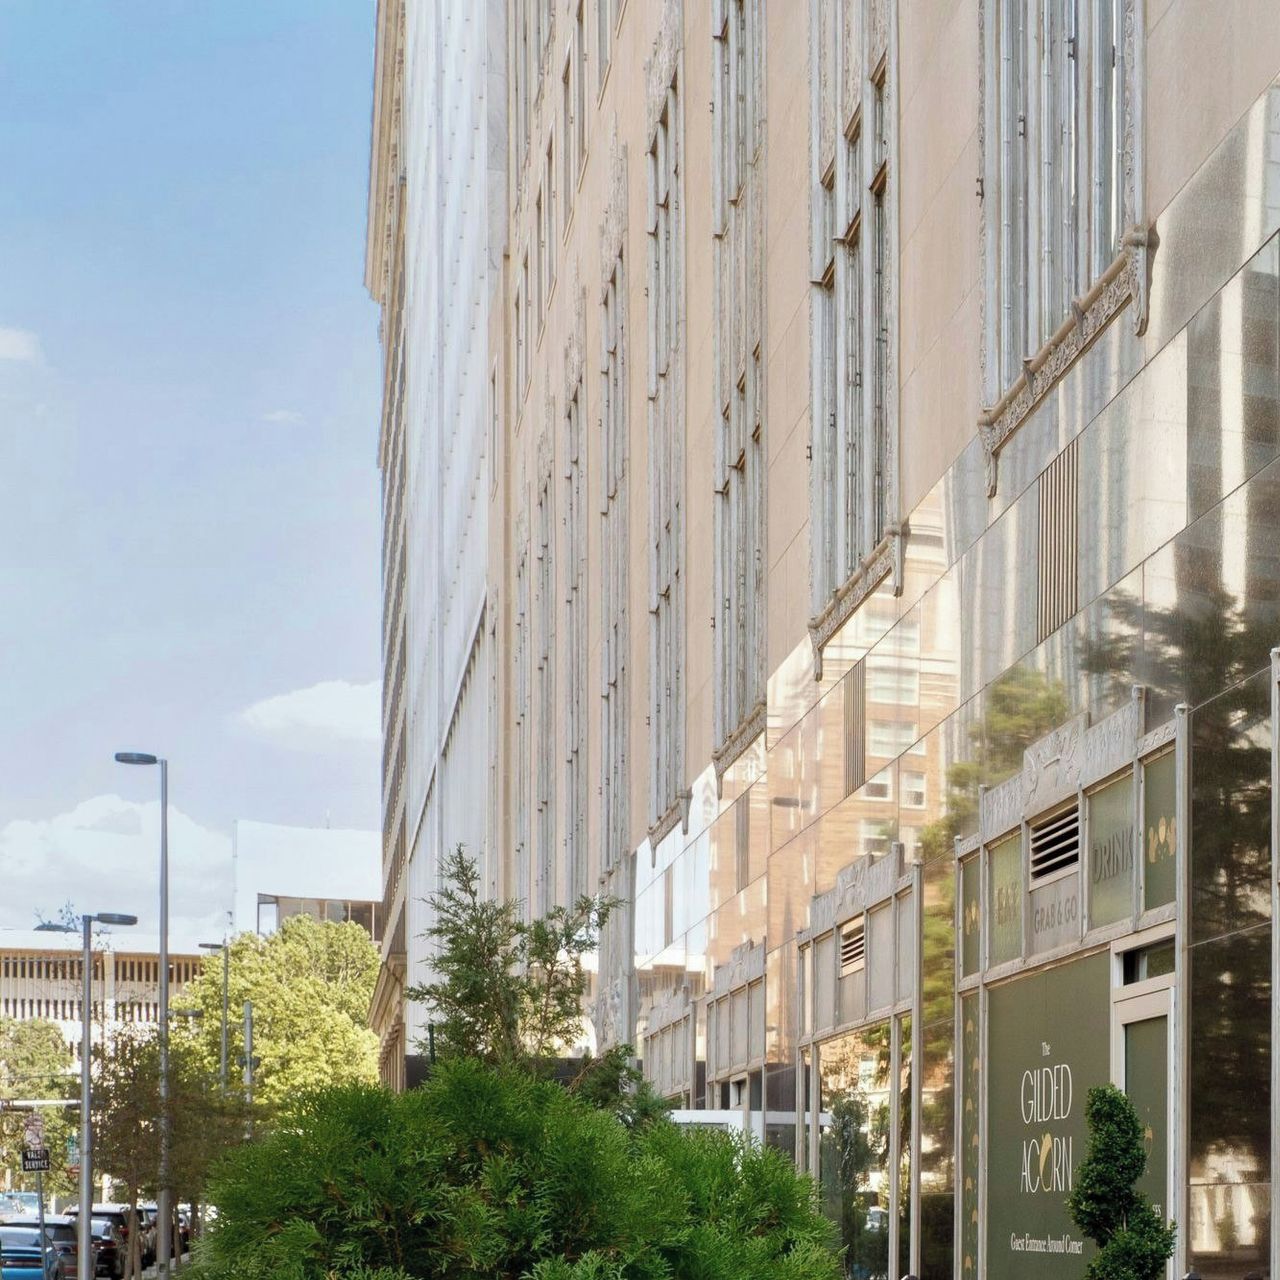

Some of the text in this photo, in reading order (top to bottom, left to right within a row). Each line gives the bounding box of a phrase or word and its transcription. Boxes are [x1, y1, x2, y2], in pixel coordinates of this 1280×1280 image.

[1034, 903, 1055, 934] GRAB
[1064, 895, 1078, 923] GO
[1042, 1041, 1051, 1057] The
[1021, 1064, 1072, 1125] GILDED
[1021, 1133, 1073, 1193] ACORN
[1010, 1232, 1025, 1251] Guest
[1047, 1234, 1065, 1253] Around
[1065, 1234, 1083, 1255] Corner
